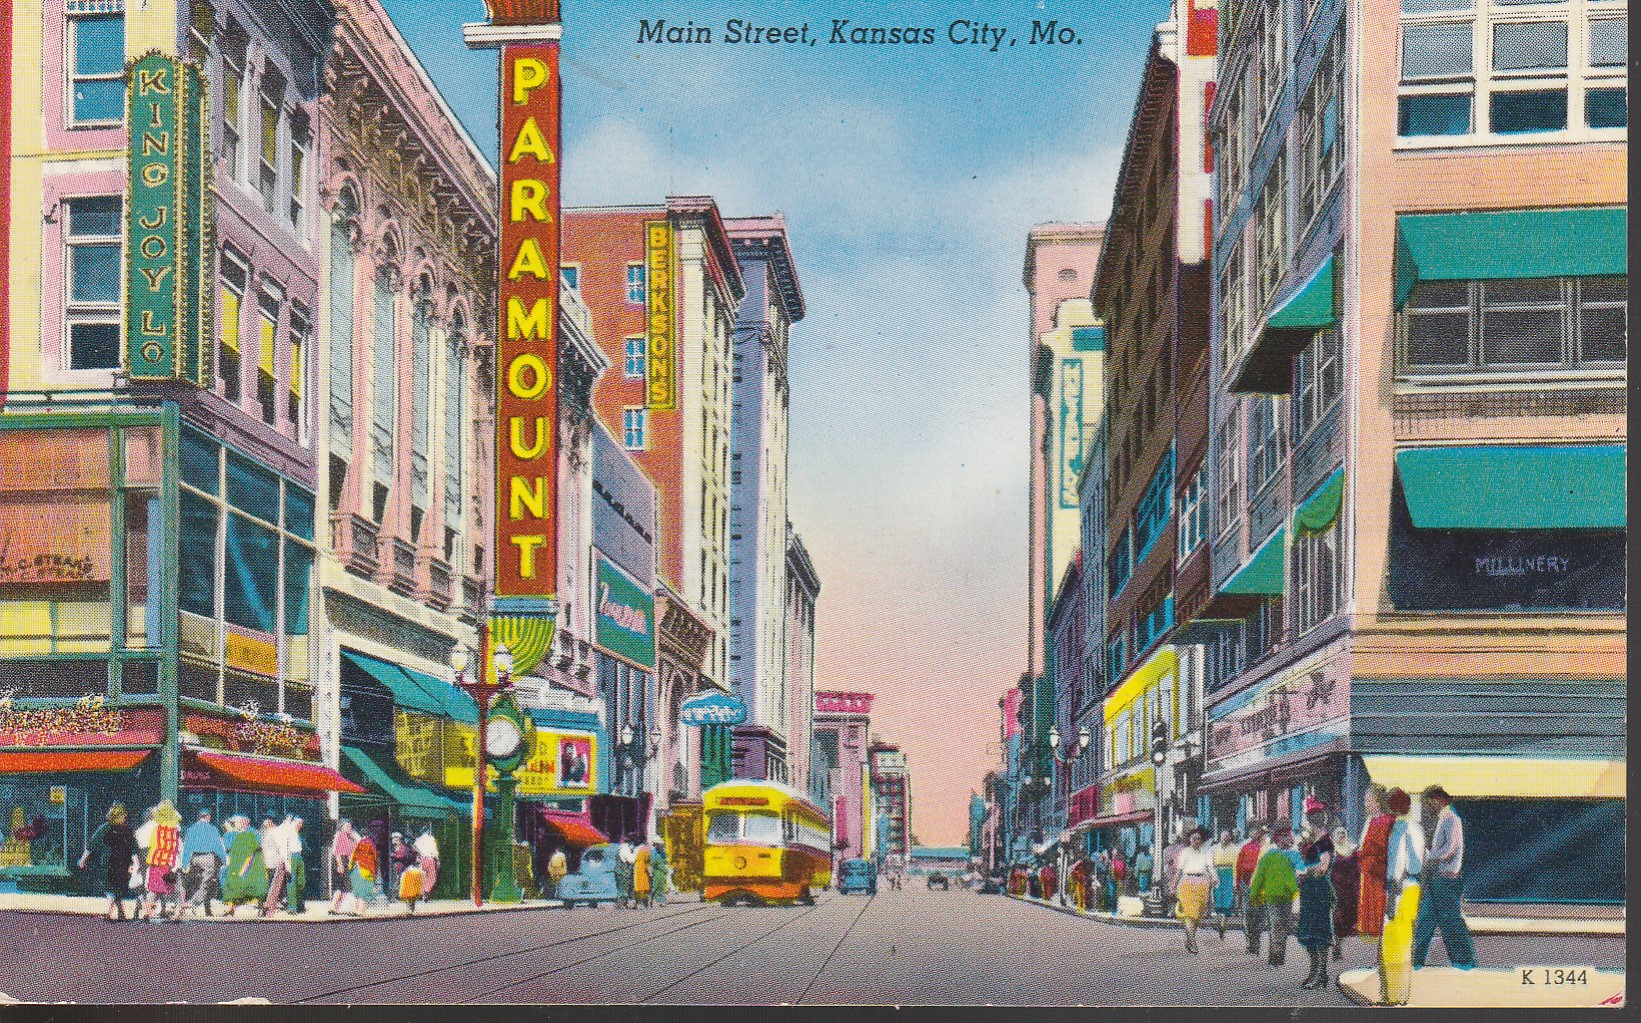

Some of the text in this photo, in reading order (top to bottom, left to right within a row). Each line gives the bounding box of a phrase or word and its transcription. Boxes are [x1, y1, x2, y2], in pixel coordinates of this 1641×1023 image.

[139, 68, 172, 364] KING JOY LO
[506, 57, 556, 580] PARAMOUNT
[650, 226, 669, 402] BERKSONS
